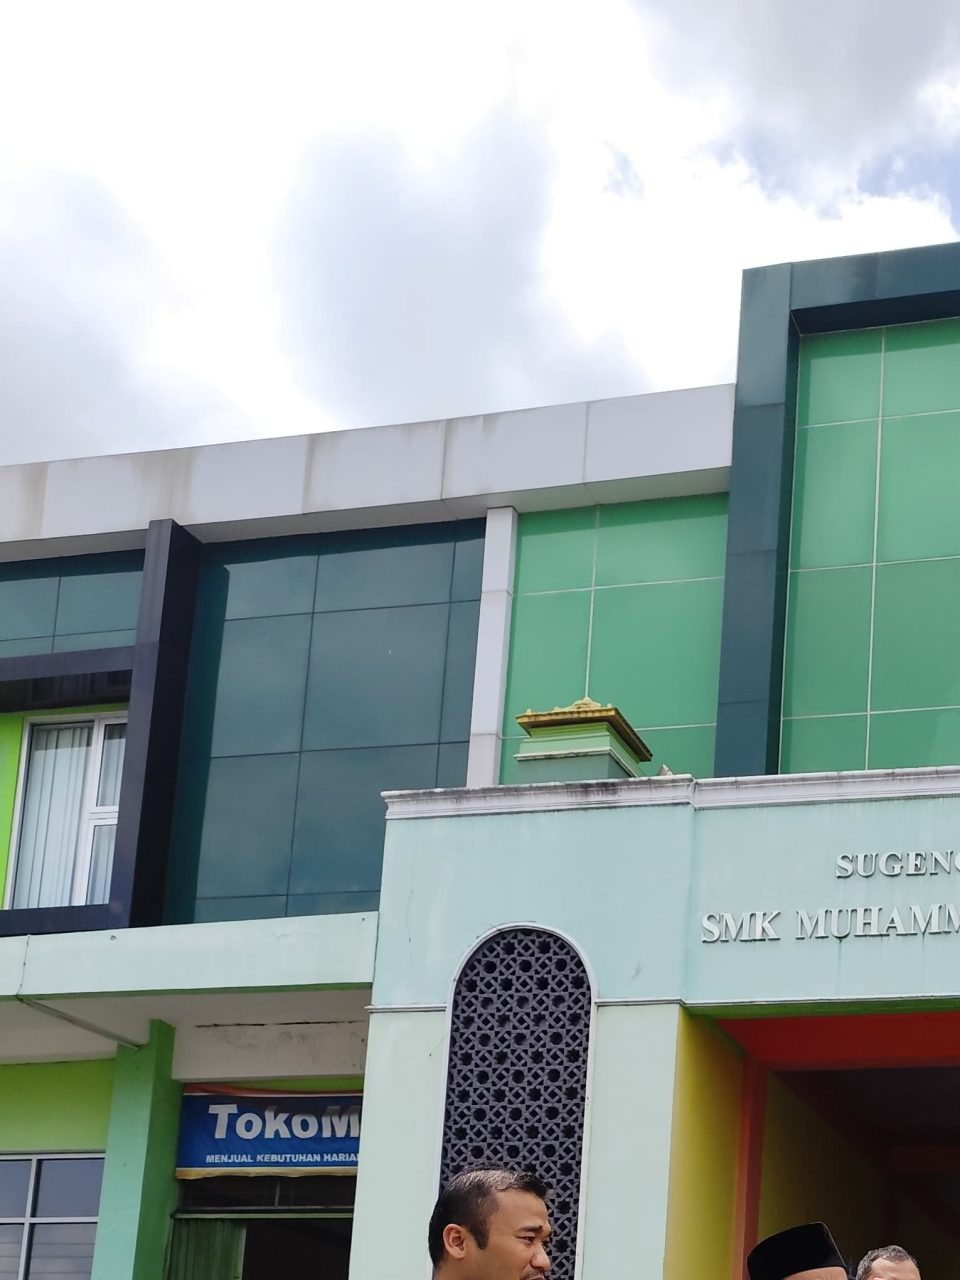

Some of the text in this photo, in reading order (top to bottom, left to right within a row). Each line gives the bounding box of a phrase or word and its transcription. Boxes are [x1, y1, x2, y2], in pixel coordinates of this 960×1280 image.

[701, 910, 781, 943] SMK
[206, 1154, 253, 1163] MENJUAL
[256, 1153, 321, 1163] KEBUTUHAN
